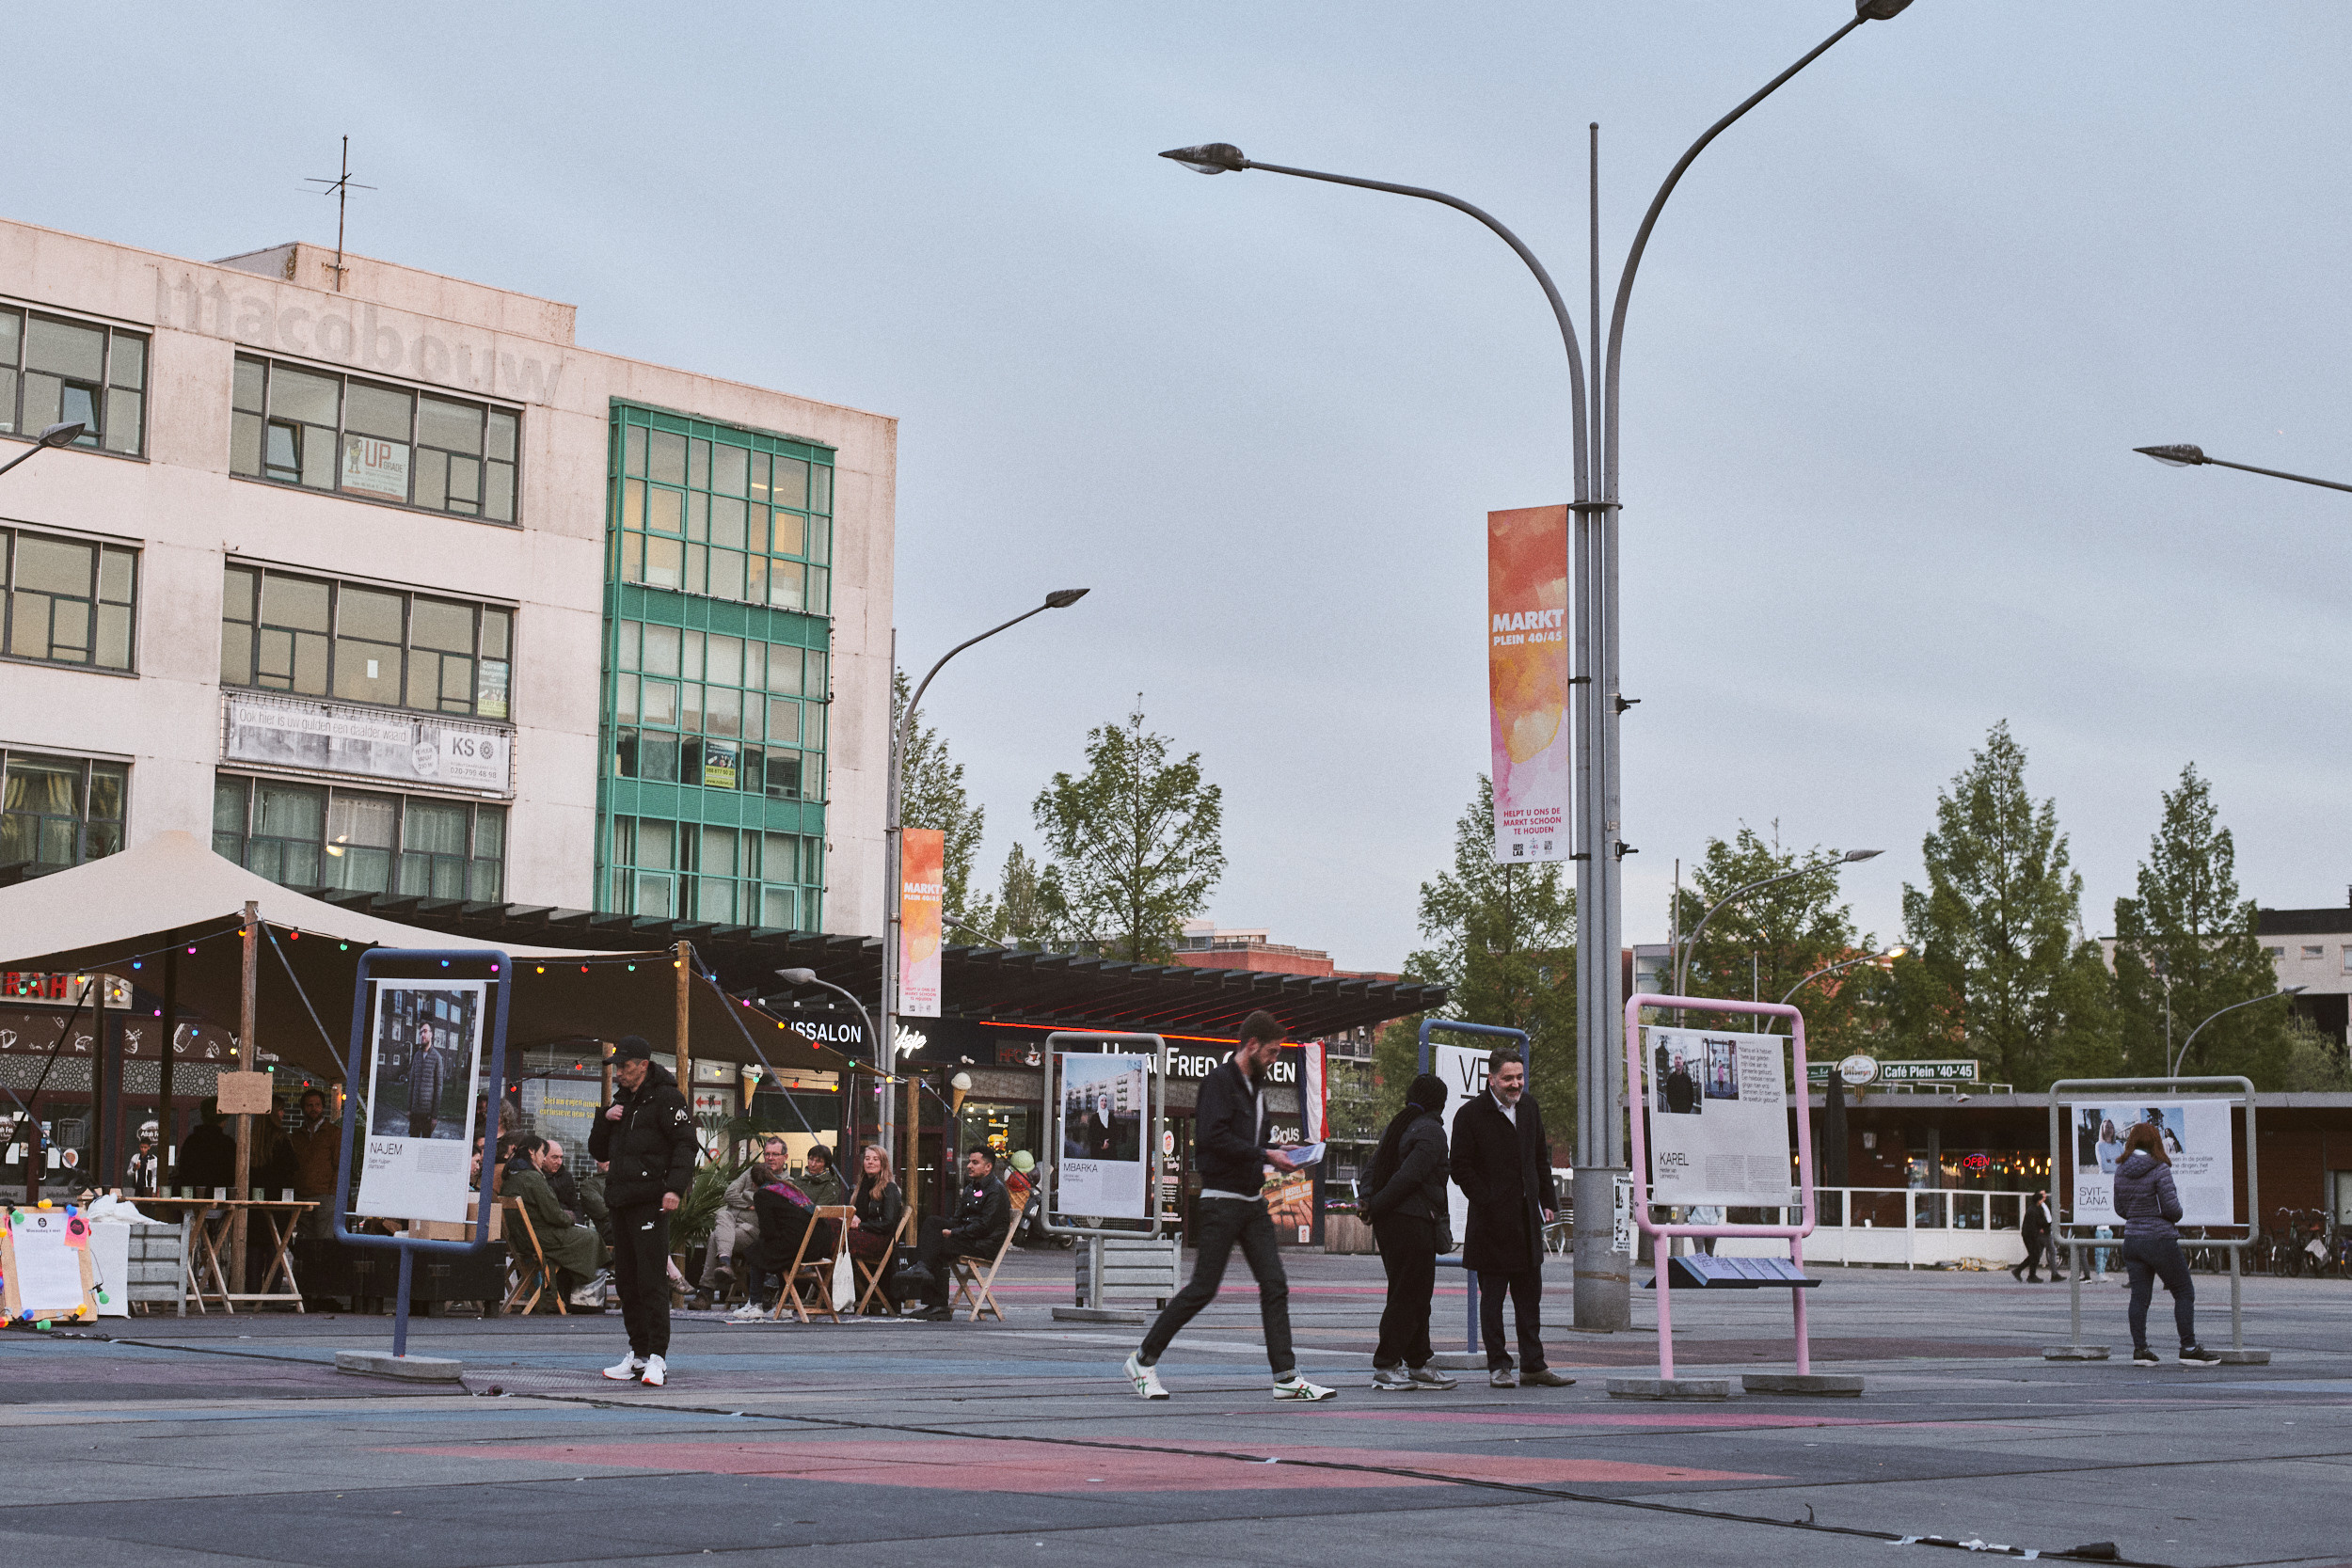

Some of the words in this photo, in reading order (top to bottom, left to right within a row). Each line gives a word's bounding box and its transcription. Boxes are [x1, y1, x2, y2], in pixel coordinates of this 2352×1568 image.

[365, 439, 391, 469] UP
[383, 461, 403, 473] GRADE
[1492, 609, 1565, 633] MARKT
[1493, 634, 1524, 646] PLEIN
[1528, 631, 1563, 643] 40/45
[239, 708, 257, 722] Ook
[259, 709, 275, 725] hier
[278, 714, 285, 727] is
[287, 717, 300, 729] uw
[301, 717, 330, 733] gulden
[332, 723, 348, 735] een
[350, 723, 381, 738] daalder
[382, 728, 406, 743] waard
[453, 736, 475, 757] KS
[450, 767, 477, 777] 020-799
[1534, 808, 1549, 816] ONS
[1503, 818, 1528, 827] MARKT
[1530, 816, 1562, 825] SCHOON
[1523, 826, 1554, 834] HOUDEN
[903, 882, 942, 895] MARKT
[999, 1048, 1024, 1064] HFC
[1166, 1047, 1218, 1078] FRIED
[1884, 1065, 1907, 1078] Café
[1909, 1065, 1934, 1078] Plein
[1937, 1065, 1973, 1077] '40-'45
[370, 1142, 403, 1155] NAJEM
[1660, 1151, 1690, 1166] KAREL
[1963, 1157, 1991, 1167] OPEN
[1063, 1163, 1099, 1173] MBARKA
[2079, 1196, 2107, 1206] LANA
